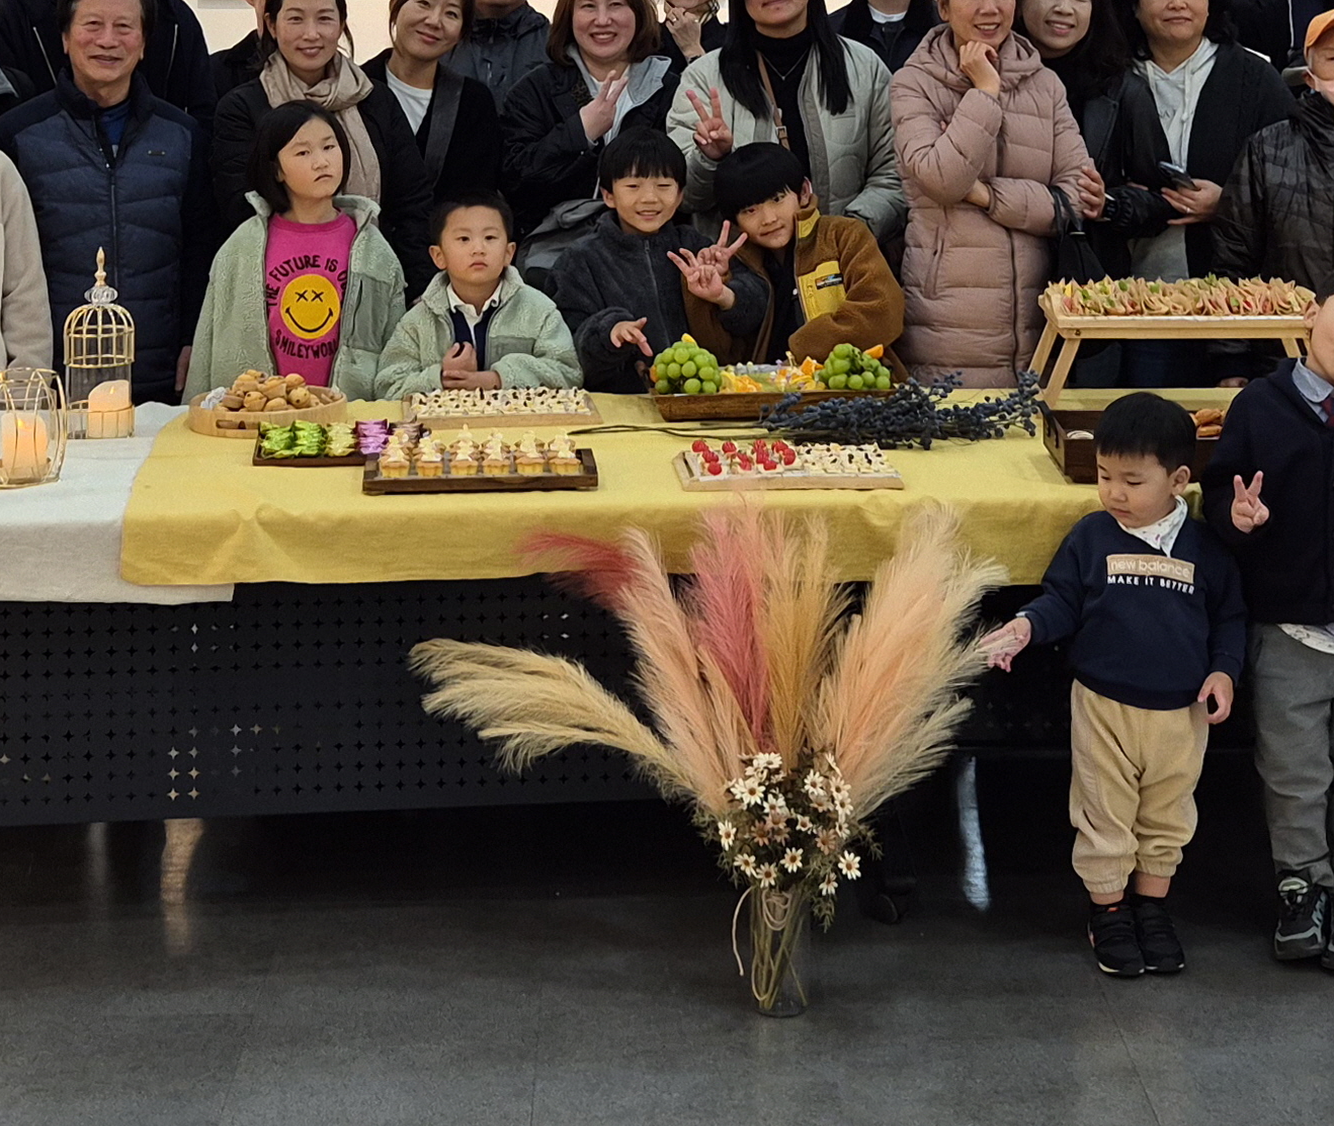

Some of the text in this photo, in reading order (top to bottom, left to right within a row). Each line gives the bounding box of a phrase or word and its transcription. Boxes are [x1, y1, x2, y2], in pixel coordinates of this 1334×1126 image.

[268, 254, 322, 283] FUTURE
[323, 257, 339, 273] IS
[1110, 559, 1192, 578] new balance
[1107, 575, 1195, 594] MAKE IT BETTER
